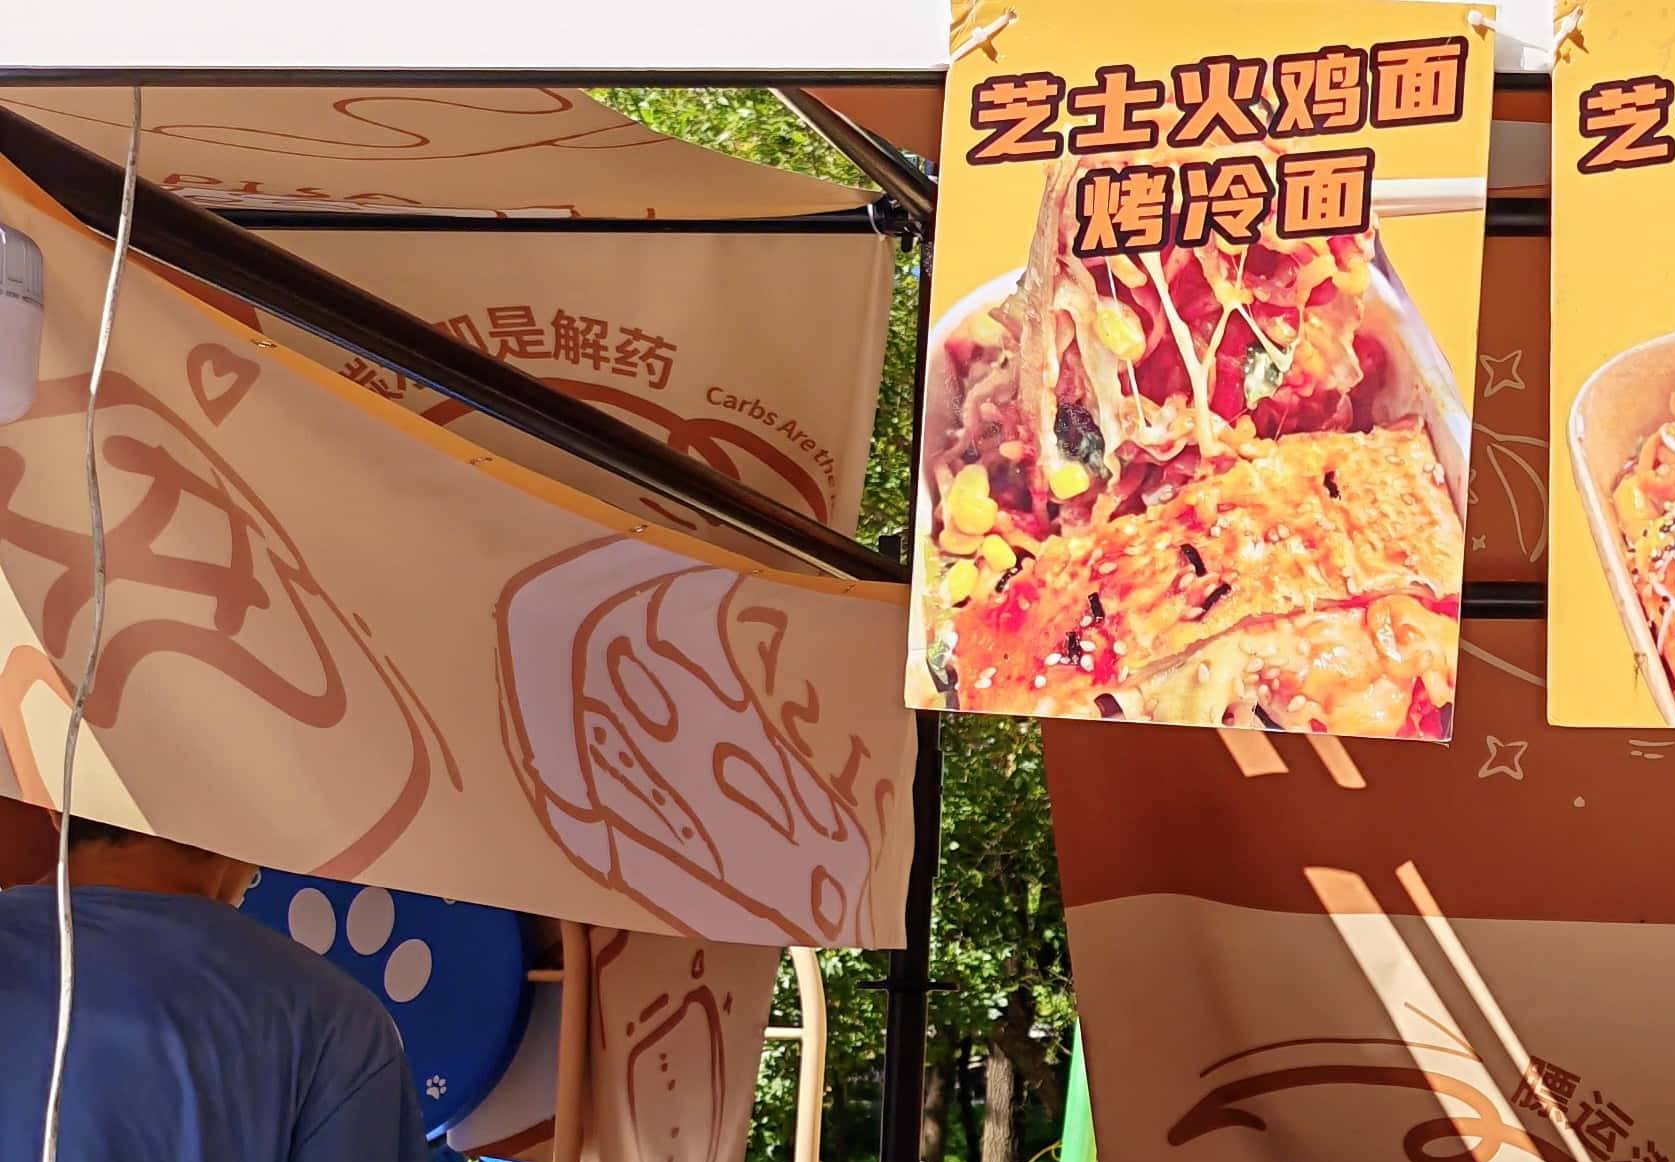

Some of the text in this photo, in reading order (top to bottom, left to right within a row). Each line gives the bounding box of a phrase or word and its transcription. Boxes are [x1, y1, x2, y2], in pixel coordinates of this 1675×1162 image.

[966, 36, 1469, 165] 芝士火鸡面
[1073, 147, 1375, 258] 烤冷面
[706, 386, 778, 426] Carbs
[776, 419, 816, 452] Are
